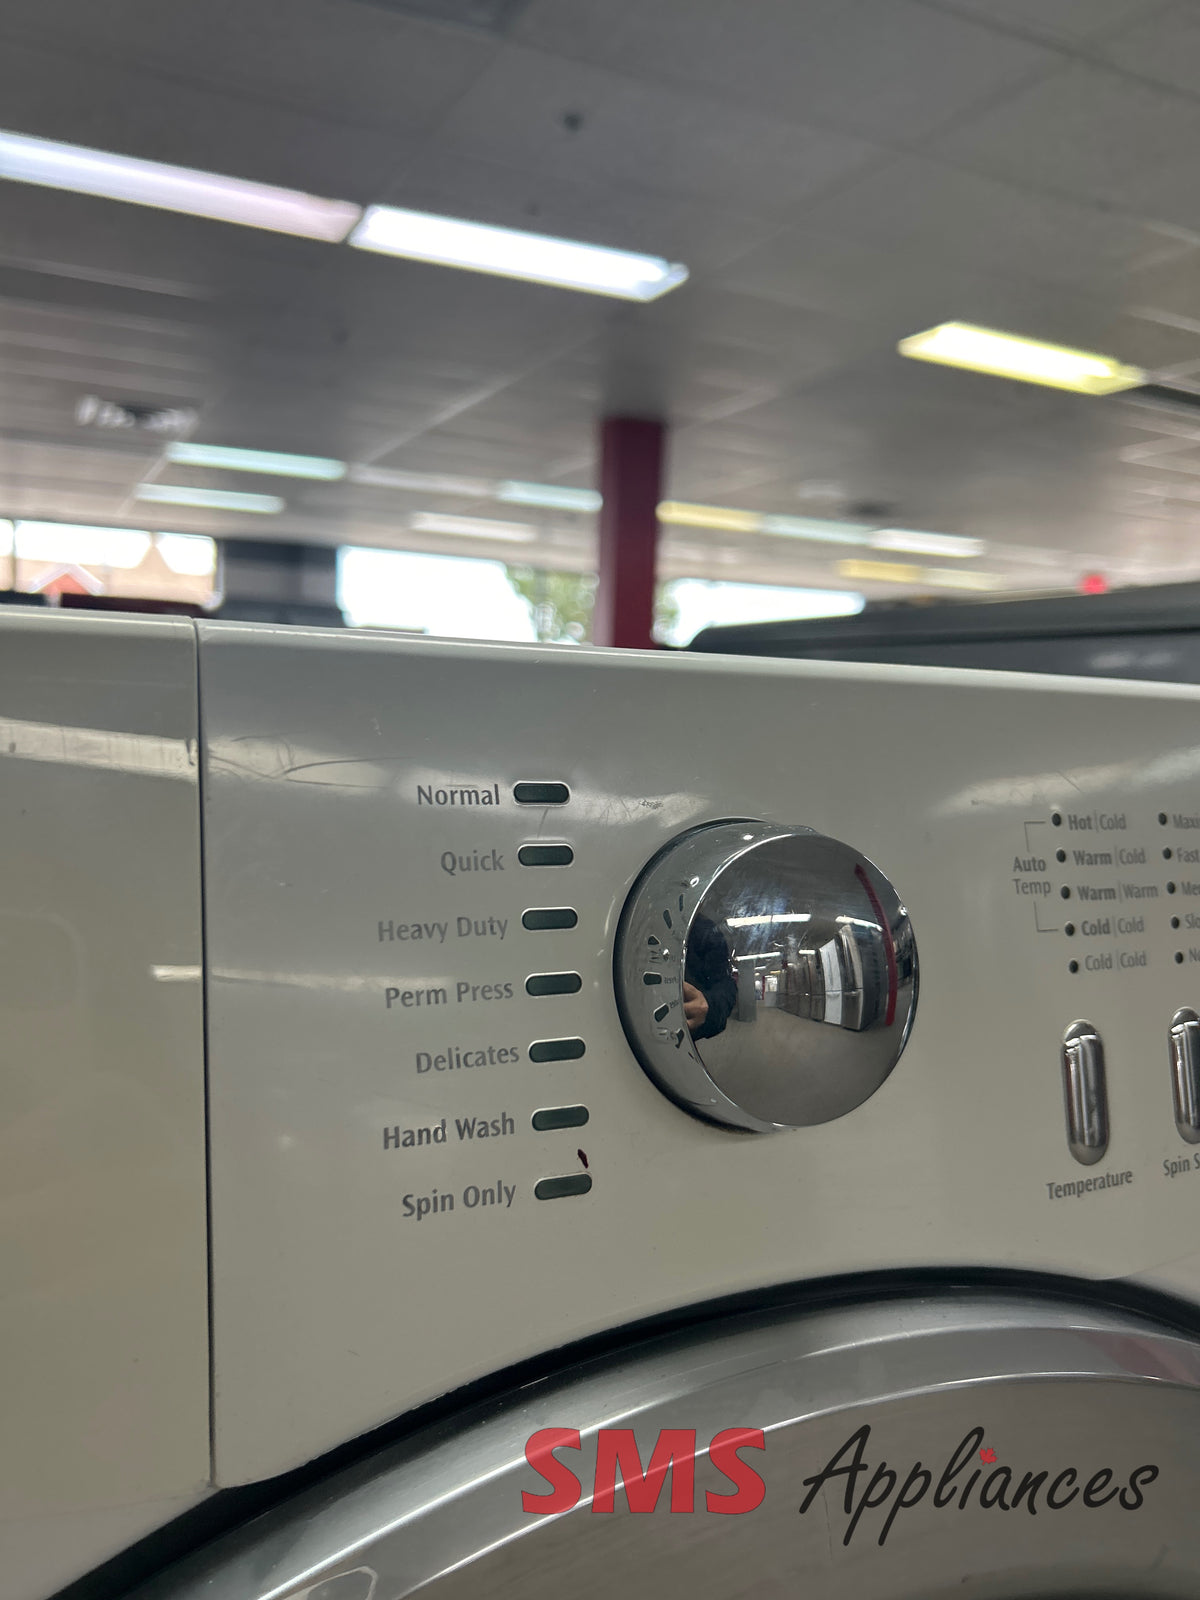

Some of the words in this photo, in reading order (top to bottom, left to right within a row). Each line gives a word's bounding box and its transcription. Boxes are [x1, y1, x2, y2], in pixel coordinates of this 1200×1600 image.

[416, 784, 501, 806] Normal
[1068, 814, 1093, 831] Hot
[1099, 813, 1127, 830] Cold
[1172, 813, 1200, 830] Maxi
[440, 849, 505, 876] Quick
[1012, 856, 1047, 872] Auto
[1073, 850, 1113, 866] Warm
[1118, 847, 1147, 865] Cold
[1012, 878, 1052, 897] Temp
[1077, 886, 1117, 901] Warm
[1121, 884, 1159, 899] Warm
[1181, 881, 1200, 896] Me
[377, 919, 448, 943] Heavy
[456, 916, 508, 940] Duty
[1081, 918, 1111, 936] Cold
[1117, 916, 1145, 934] Cold
[1084, 953, 1113, 971] Cold
[1119, 950, 1147, 968] Cold
[384, 987, 447, 1009] Perm
[456, 981, 514, 1002] Press
[415, 1046, 520, 1074] Delicates
[383, 1119, 447, 1150] Hand
[455, 1112, 515, 1141] Wash
[1162, 1155, 1190, 1179] Spin
[1046, 1170, 1133, 1200] Temperature
[402, 1189, 455, 1221] Spin
[463, 1180, 517, 1208] Only
